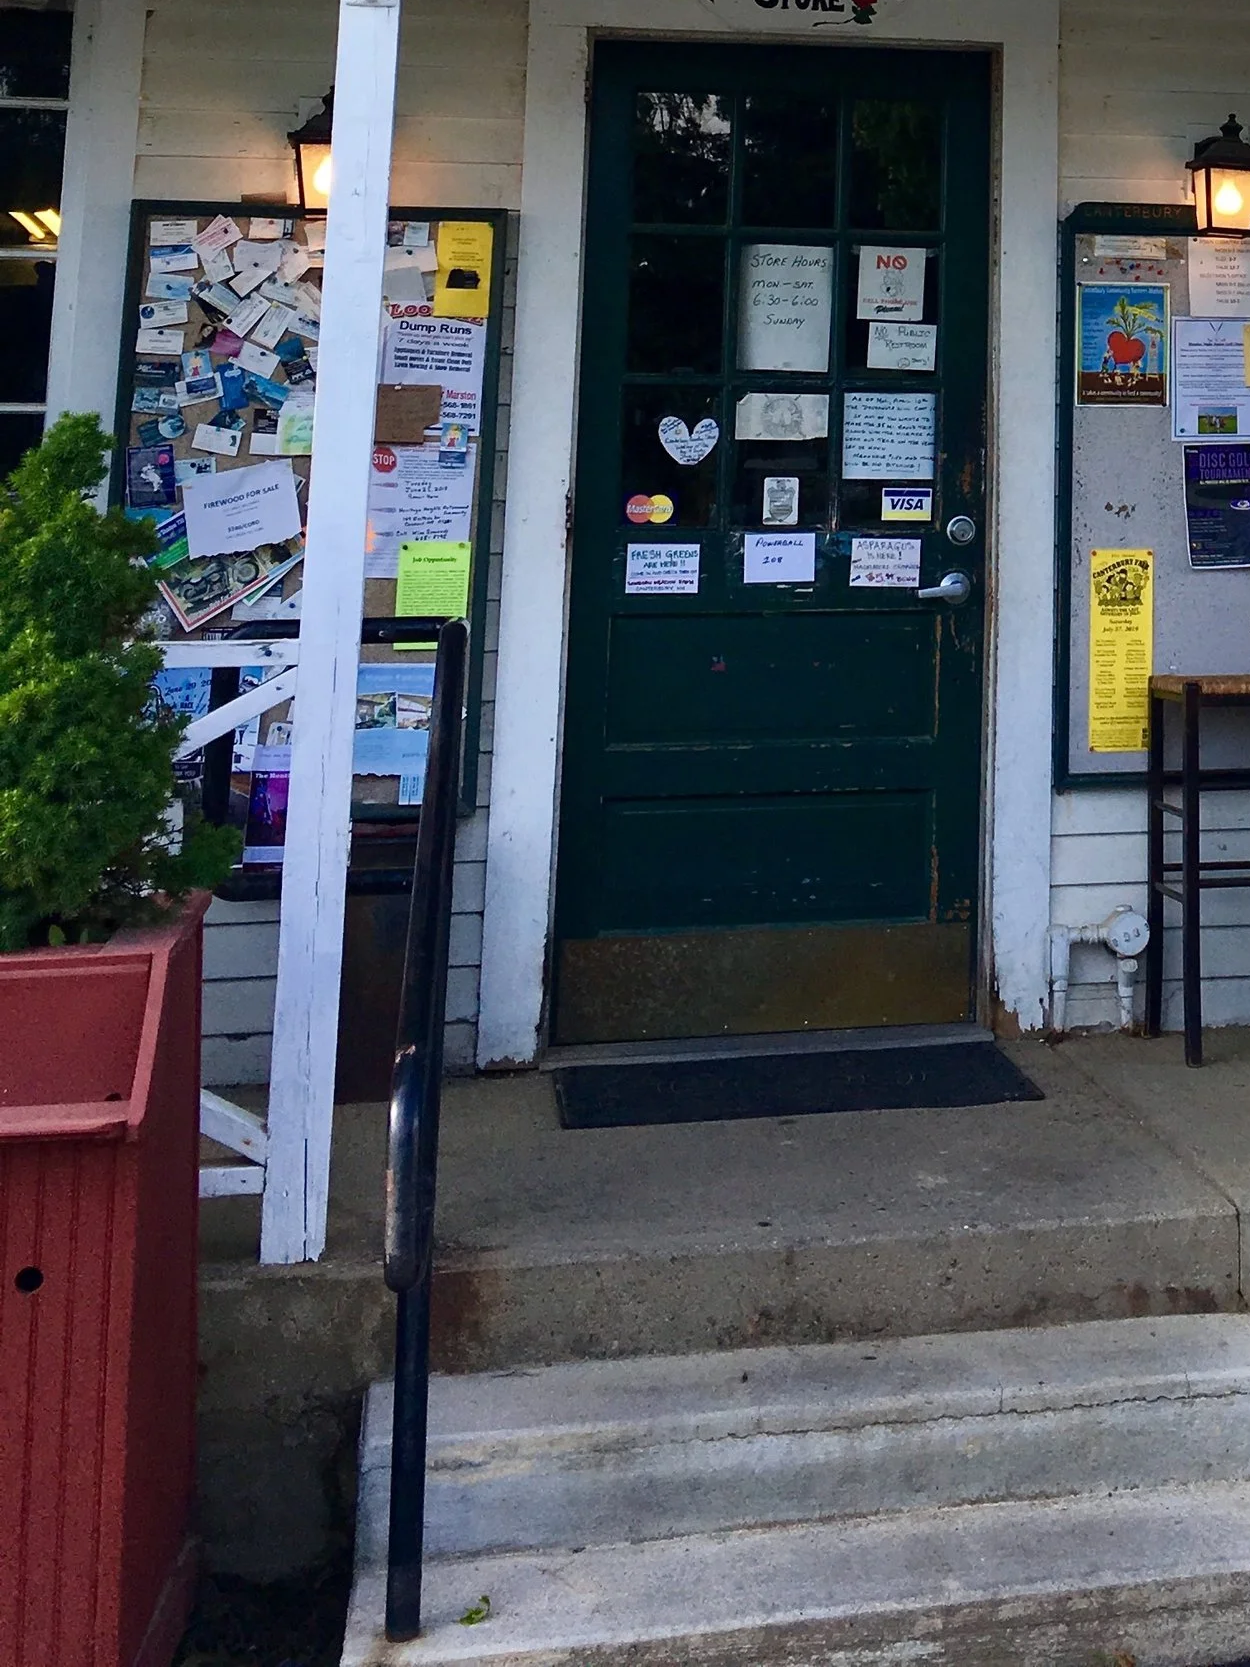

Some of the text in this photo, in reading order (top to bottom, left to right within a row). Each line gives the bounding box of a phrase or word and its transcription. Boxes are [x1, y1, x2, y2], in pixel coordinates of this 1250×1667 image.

[1083, 205, 1183, 219] CANTERBURY
[751, 253, 828, 268] STORE HOURS
[876, 254, 908, 270] NO
[399, 320, 472, 335] Dump Runs
[763, 313, 805, 329] SUNDAY
[446, 389, 477, 401] Marston
[373, 453, 395, 466] STOP
[1200, 453, 1226, 468] DISC
[203, 494, 245, 509] FIREWOOD
[245, 490, 262, 500] FOR
[262, 484, 280, 494] SALE
[626, 504, 673, 515] MasterCard
[890, 498, 924, 510] VISA
[755, 537, 804, 547] POWERBALL
[857, 541, 915, 551] ASPARAGUS
[631, 549, 698, 562] FRESH GREENS
[1092, 559, 1133, 579] CANTERBURY
